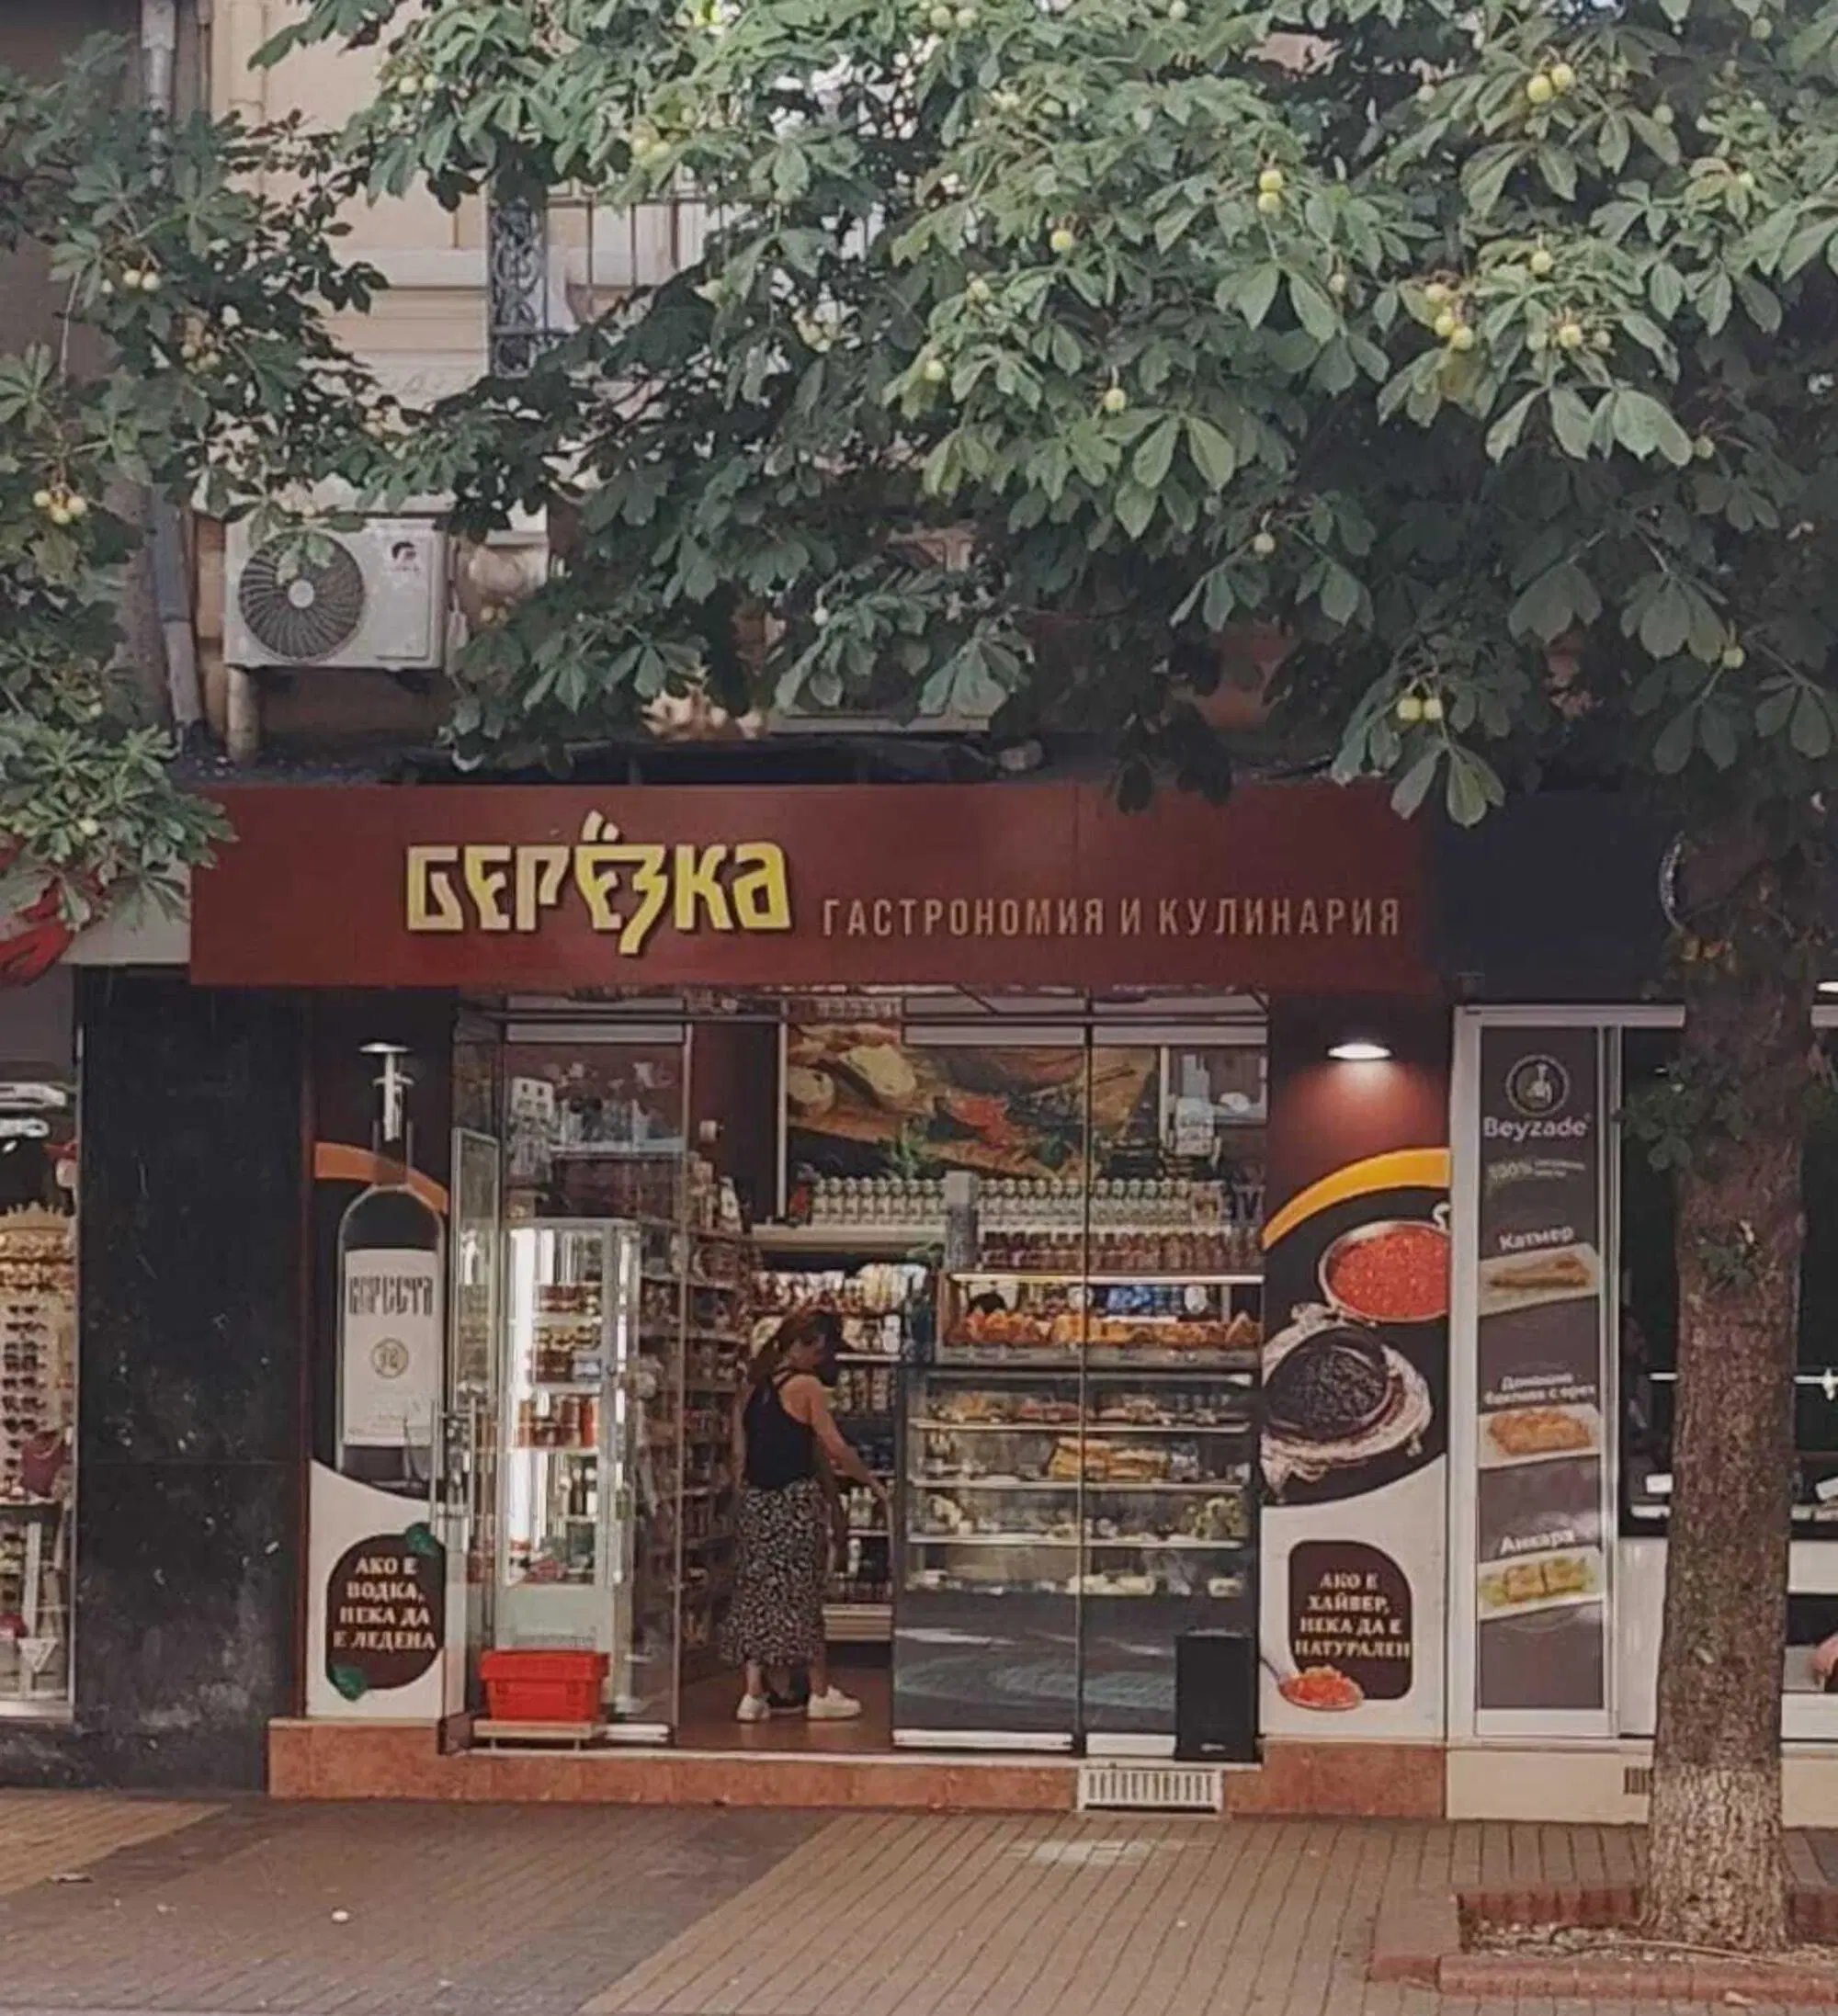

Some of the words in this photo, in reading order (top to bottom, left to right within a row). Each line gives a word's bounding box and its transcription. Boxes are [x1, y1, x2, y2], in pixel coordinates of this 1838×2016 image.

[823, 897, 1104, 936] ГАСТРОНОМИЯ
[1119, 897, 1142, 936] И
[1158, 897, 1401, 936] КУЛИНАРИЯ
[1483, 1116, 1588, 1142] Beyzade
[355, 1556, 398, 1575] АКО
[403, 1556, 417, 1575] Е
[346, 1580, 426, 1603] ВОДКА,
[1320, 1572, 1361, 1590] АКО
[1366, 1573, 1379, 1590] Е
[1308, 1591, 1390, 1614] ХАЙВЕР,
[339, 1605, 395, 1625] НЕКА
[400, 1606, 431, 1627] ДА
[1299, 1616, 1353, 1634] НЕКА
[1356, 1617, 1385, 1637] ДА
[1389, 1618, 1402, 1635] Е
[333, 1630, 346, 1648] Е
[350, 1630, 437, 1652] ЛЕДЕНА
[1294, 1638, 1411, 1659] НАТУРАЛЕН
